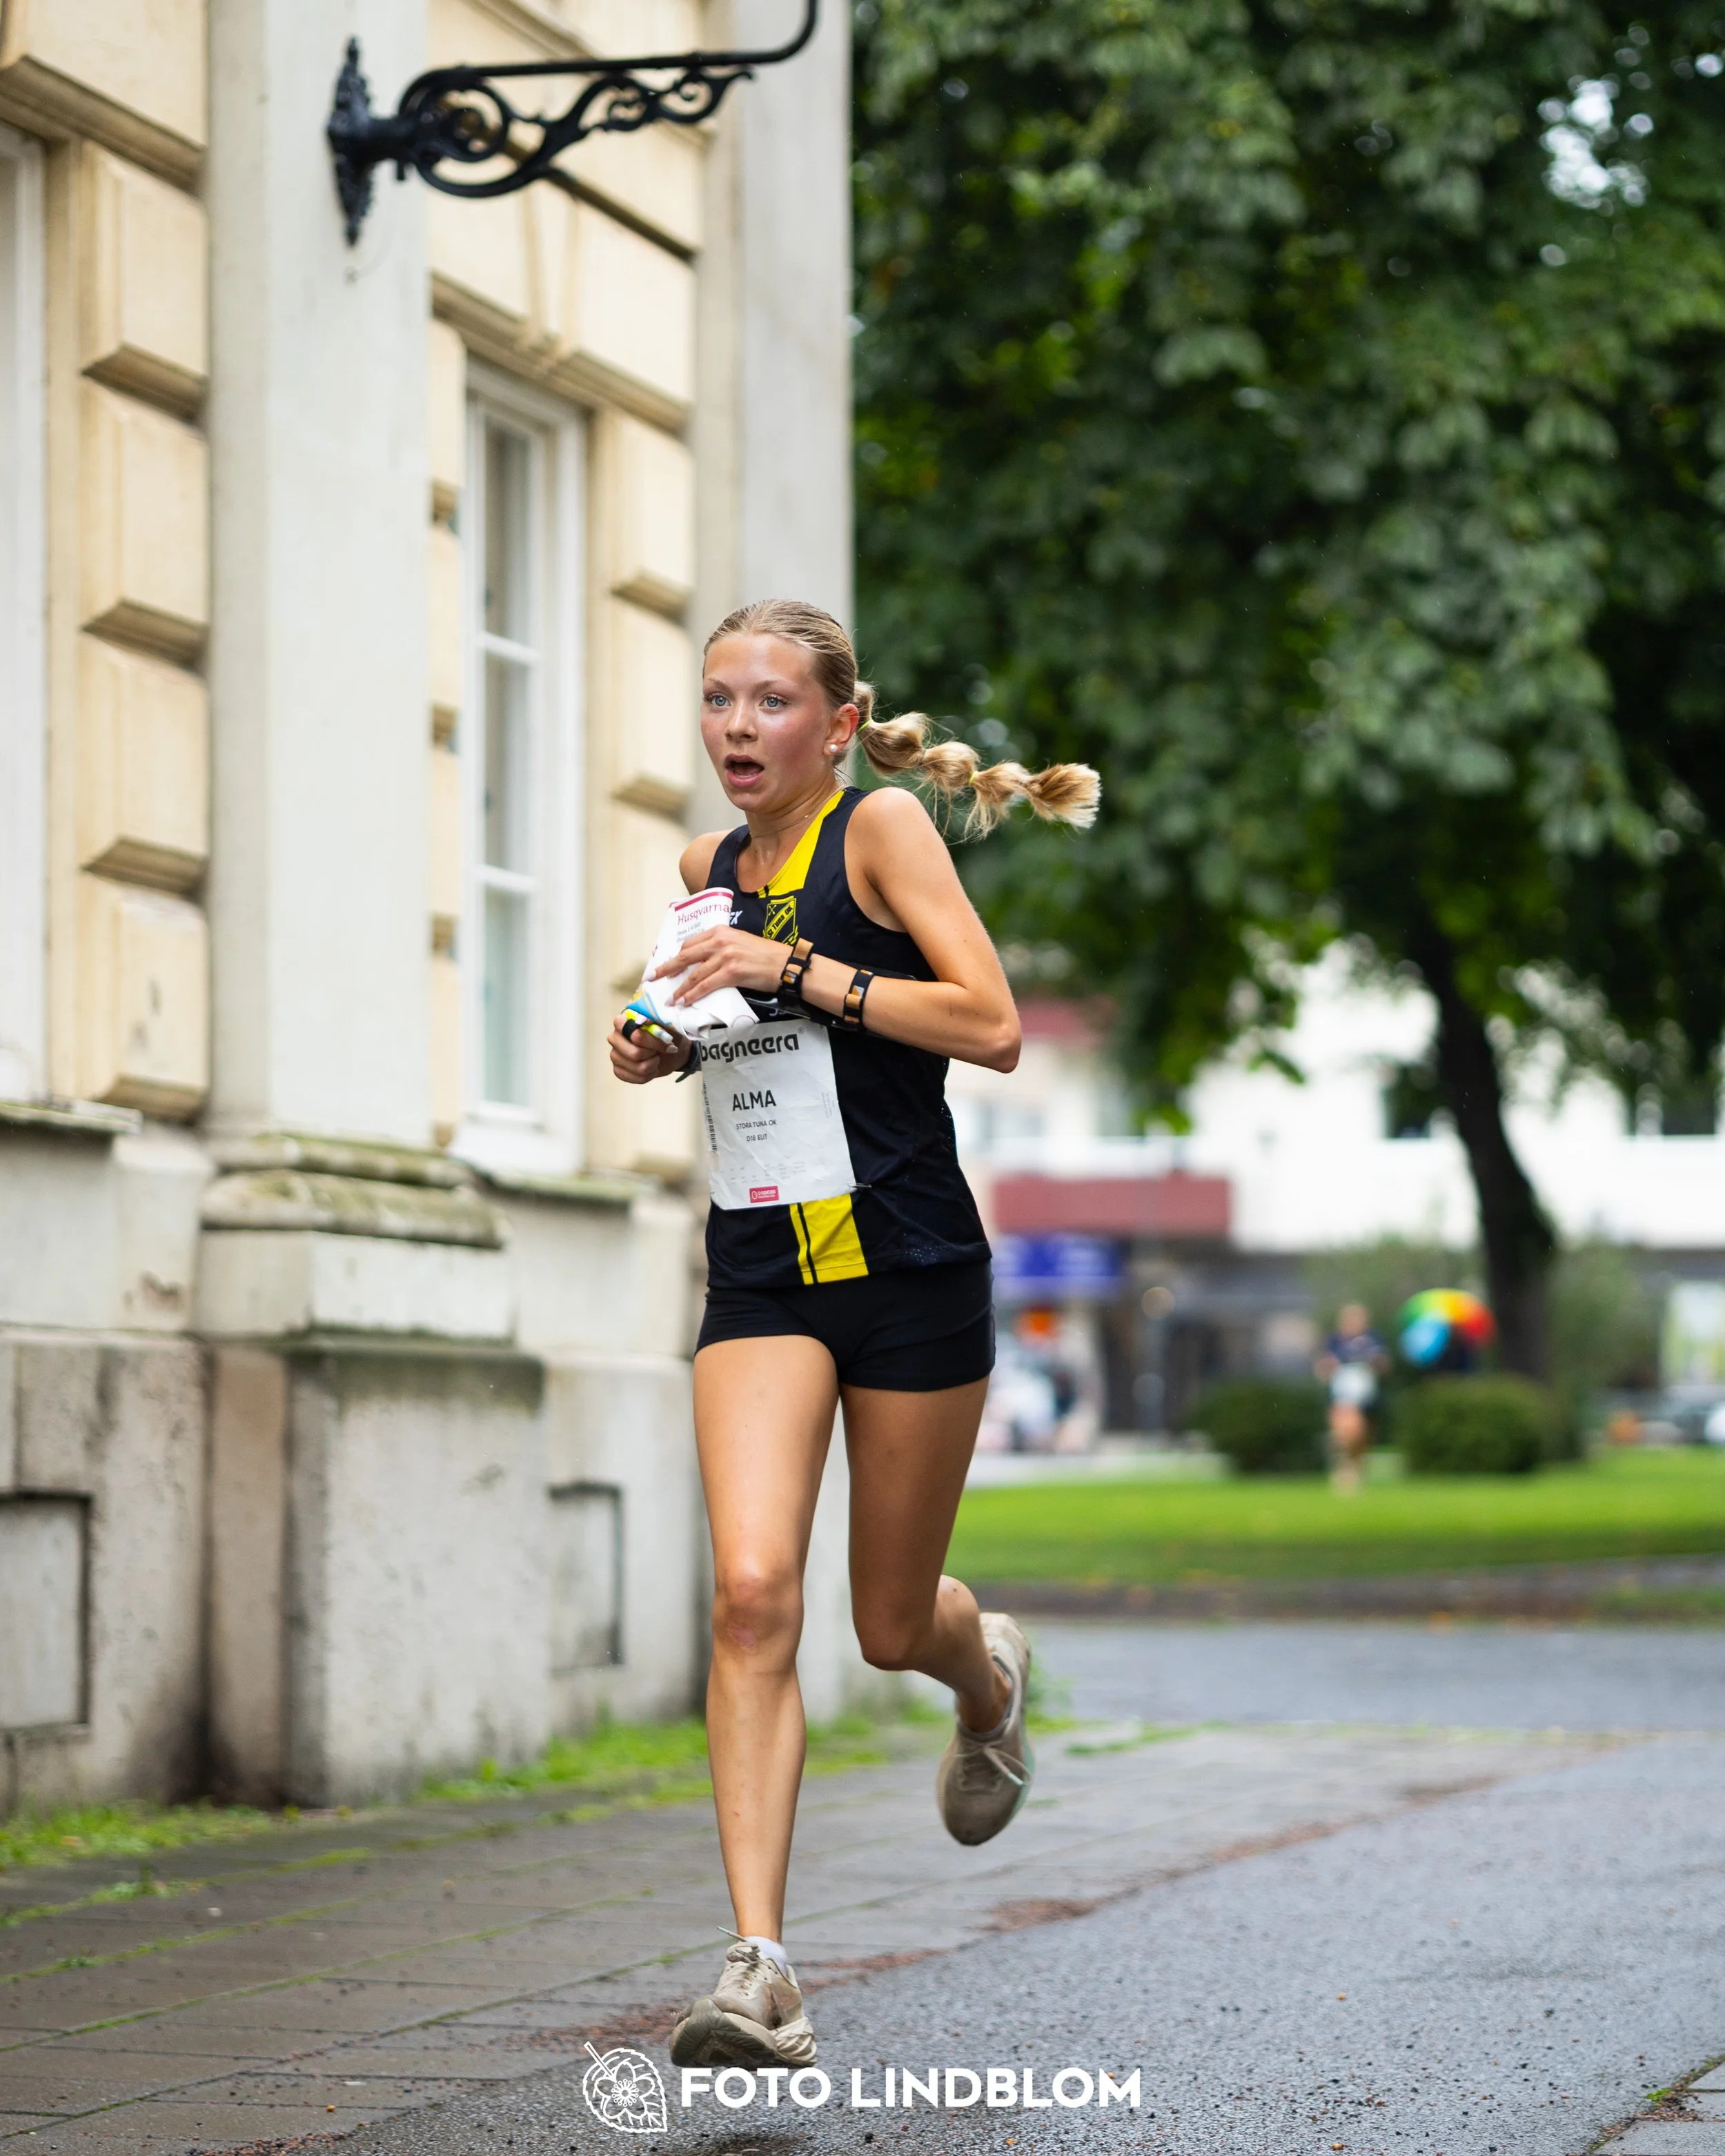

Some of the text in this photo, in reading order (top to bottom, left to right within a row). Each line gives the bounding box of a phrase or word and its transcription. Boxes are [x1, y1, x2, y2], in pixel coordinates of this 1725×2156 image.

[678, 902, 731, 925] Husqvarna
[732, 1089, 777, 1111] ALMA
[736, 1122, 752, 1130] STORA
